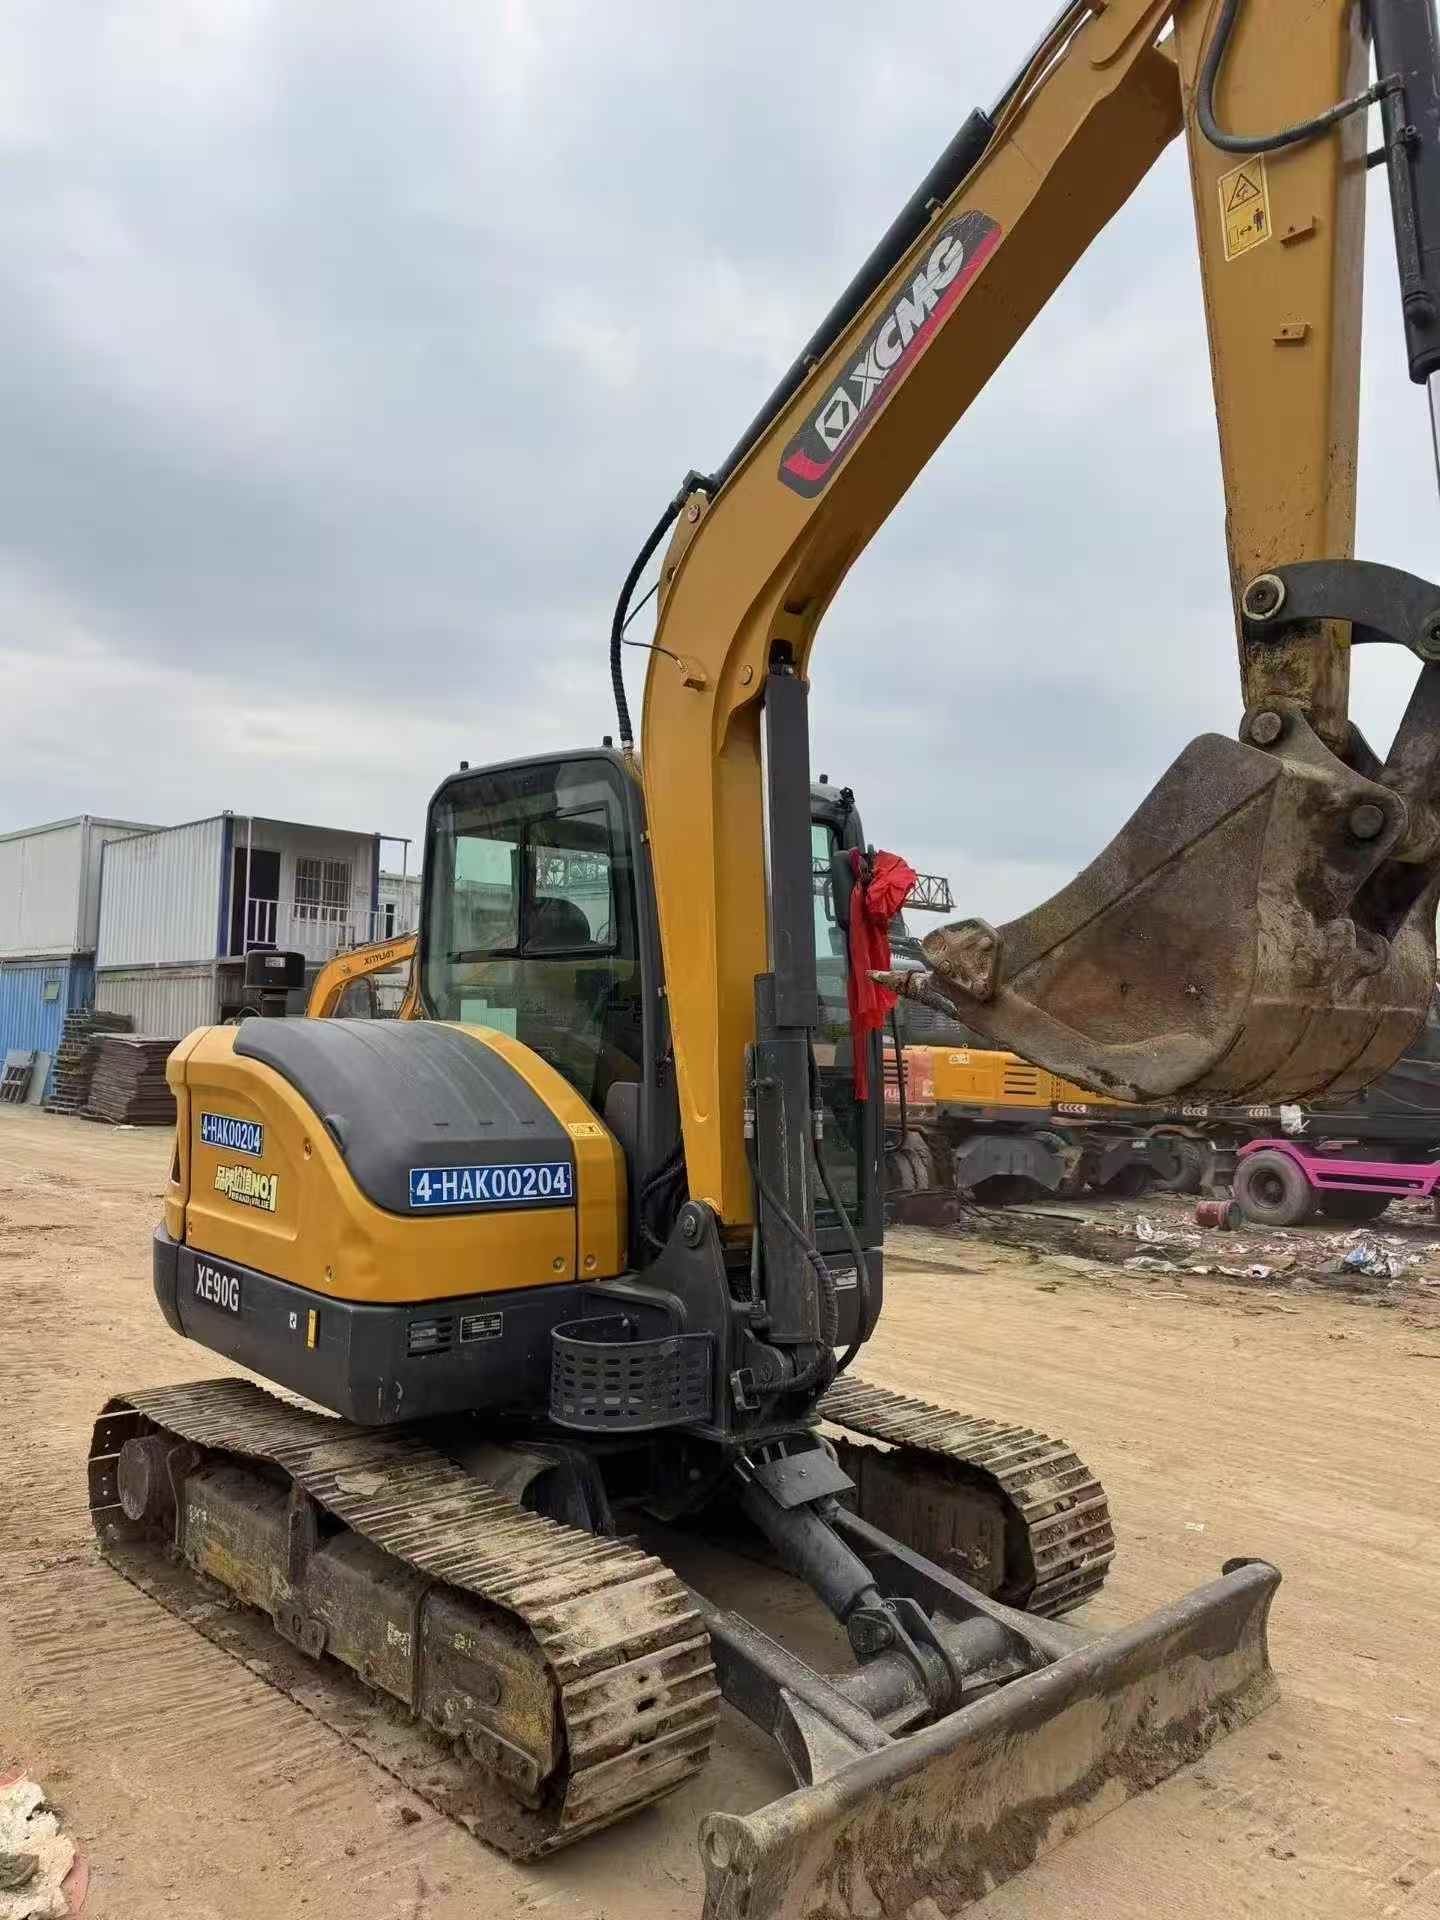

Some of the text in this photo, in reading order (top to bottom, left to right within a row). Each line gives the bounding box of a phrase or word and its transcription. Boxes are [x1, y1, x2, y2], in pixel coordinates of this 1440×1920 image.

[849, 236, 964, 411] XCMG
[203, 1115, 261, 1153] 4-HAK00204
[416, 1166, 567, 1202] 4-HAK00204
[196, 1263, 240, 1312] XE90G
